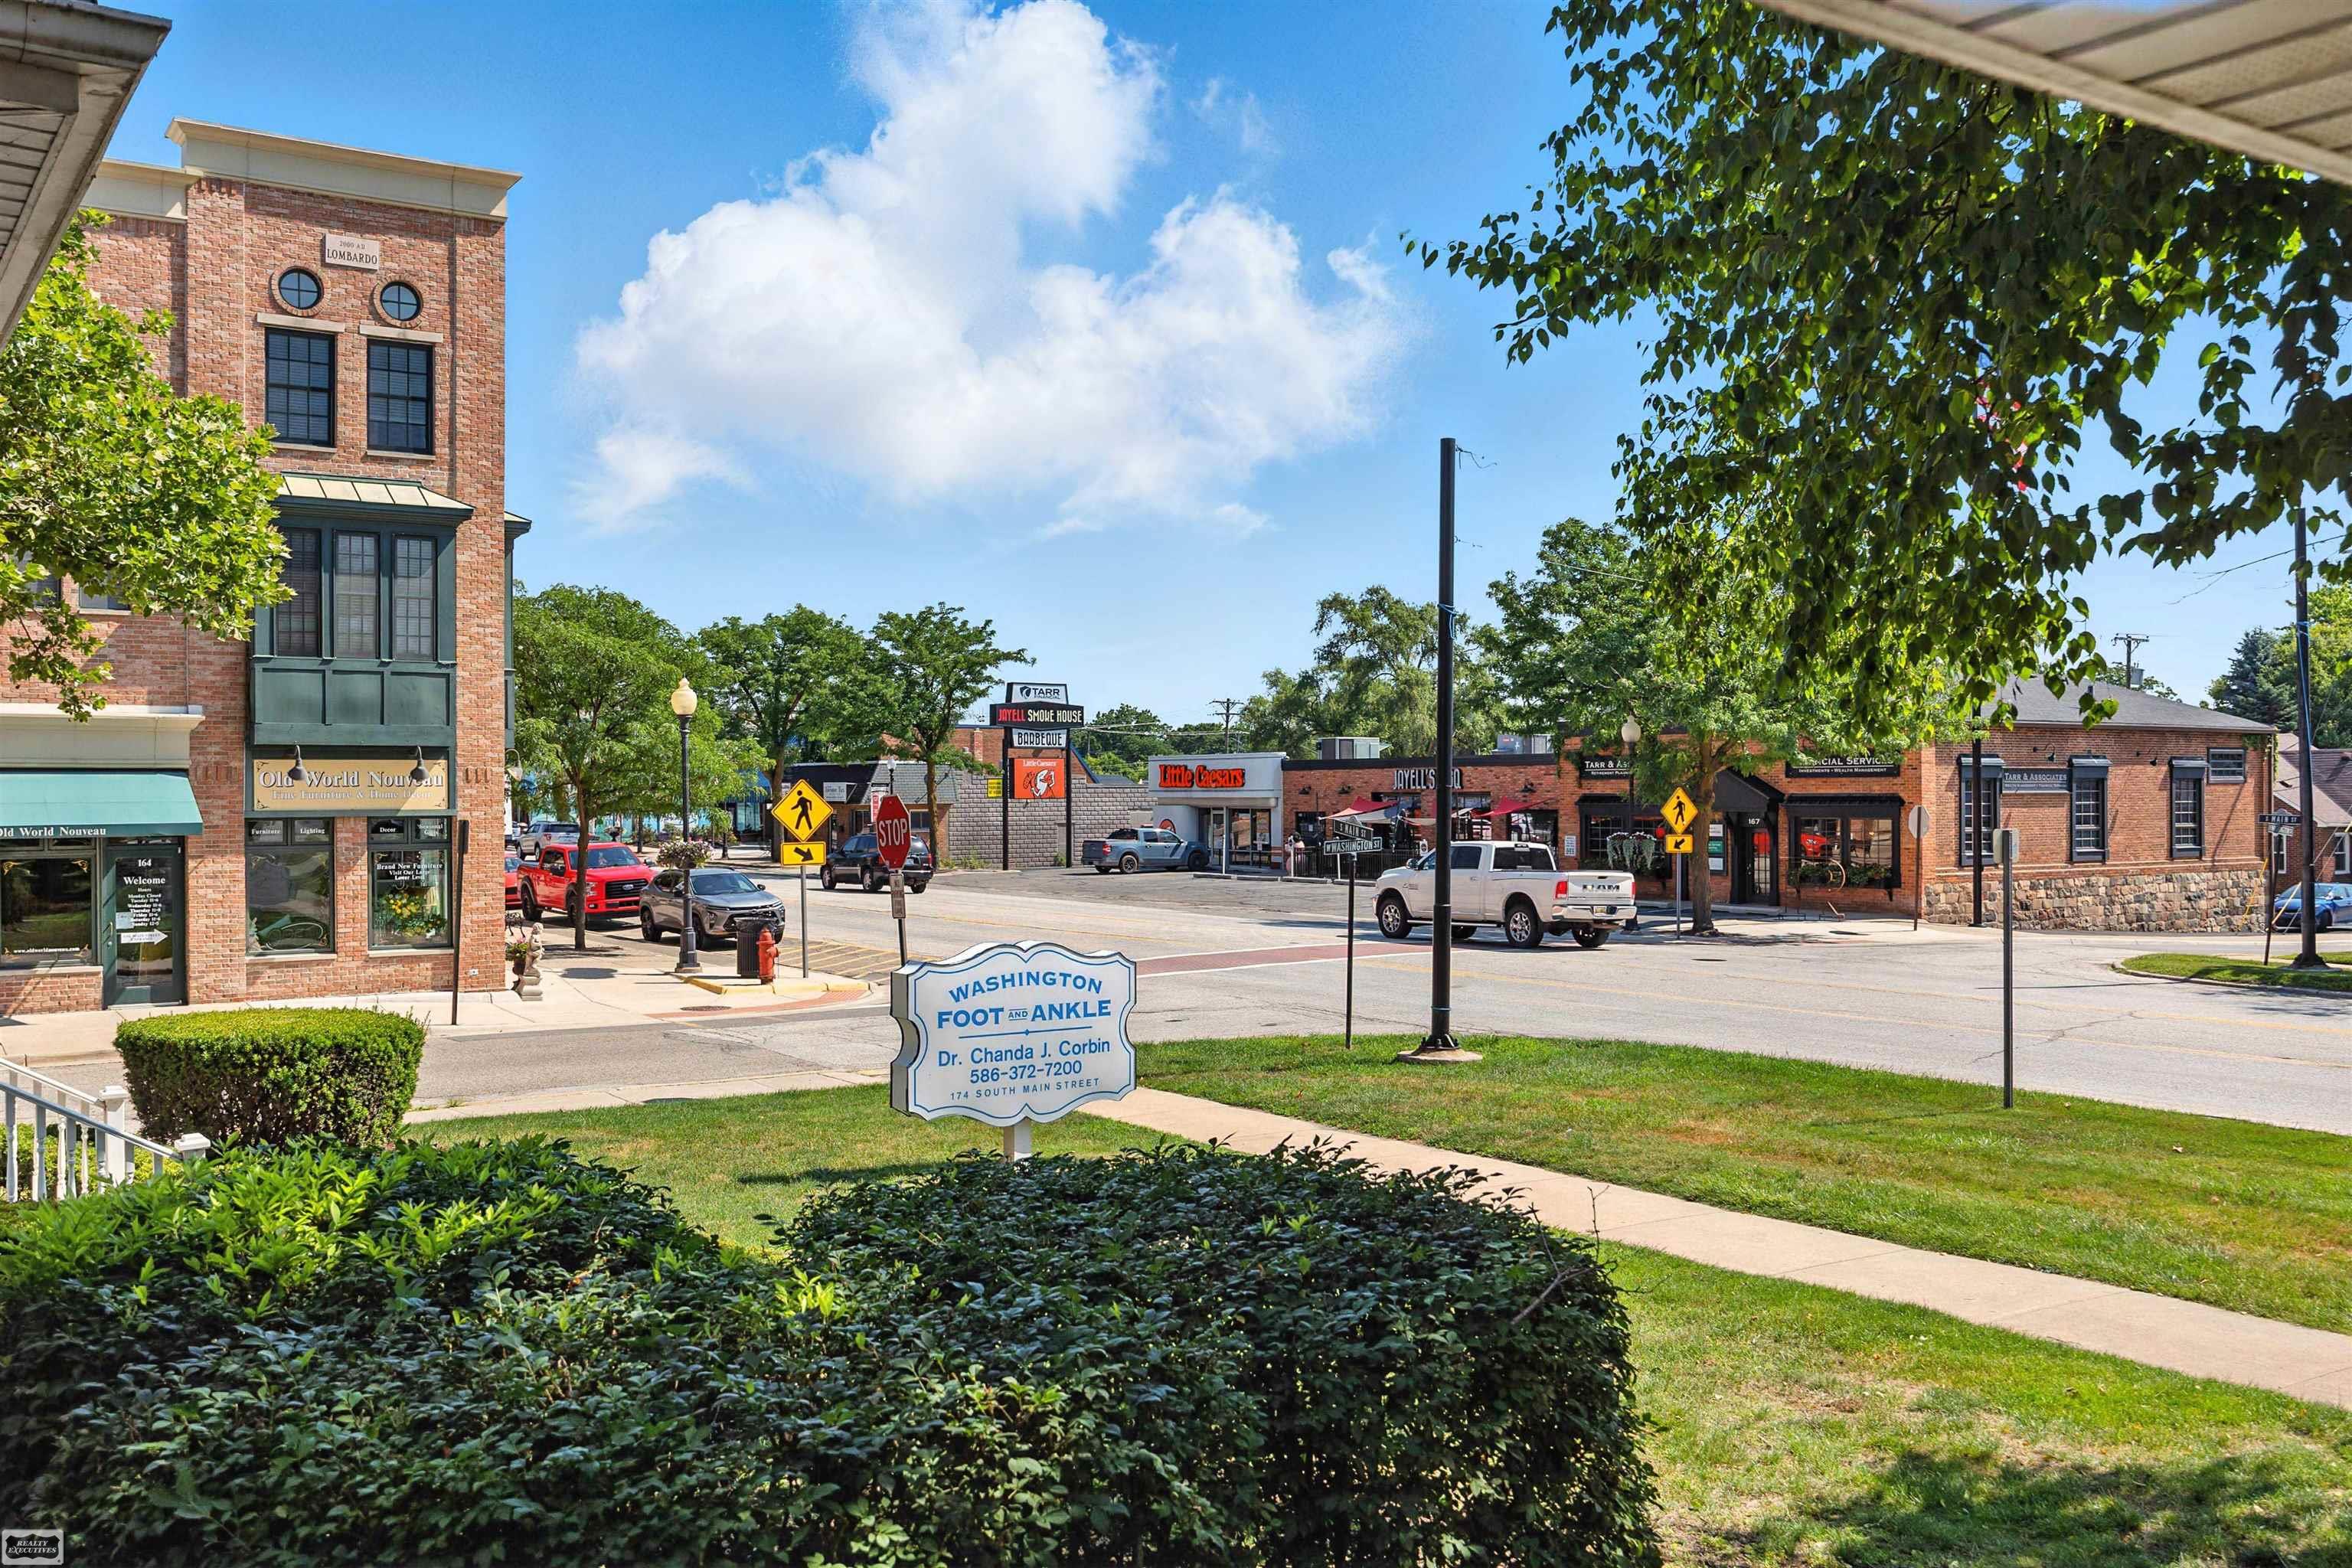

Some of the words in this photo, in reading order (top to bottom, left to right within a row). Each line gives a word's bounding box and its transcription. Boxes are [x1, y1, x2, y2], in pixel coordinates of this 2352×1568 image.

[327, 249, 377, 265] LOMBARDO
[1034, 688, 1060, 696] TARR
[998, 709, 1025, 722] JAYELL
[1027, 709, 1054, 722] SMOKE
[1057, 710, 1082, 723] HOUSE
[1018, 732, 1062, 746] BARBEQUE
[1608, 760, 1615, 769] &
[259, 771, 294, 788] Old
[305, 771, 360, 788] World
[1158, 765, 1194, 788] Little
[1195, 765, 1246, 788] Caesars
[1393, 769, 1436, 789] JAYELL'S
[19, 827, 54, 836] World
[60, 827, 106, 836] Nouveau
[879, 818, 908, 847] STOP
[1332, 841, 1373, 852] WASHINGTON
[949, 971, 1102, 1003] WASHINGTON
[937, 1007, 1004, 1029] FOOT
[1008, 1010, 1028, 1019] AND
[1031, 999, 1112, 1022] ANKLE
[938, 1050, 962, 1067] Dr.
[970, 1045, 1034, 1063] Chanda
[1040, 1043, 1051, 1058] J.
[1058, 1038, 1111, 1057] Corbin
[969, 1060, 1083, 1084] 586-372-7200
[950, 1091, 969, 1100] 174
[975, 1086, 1016, 1098] SOUTH
[1022, 1083, 1050, 1093] MAIN
[1056, 1077, 1099, 1090] STREET
